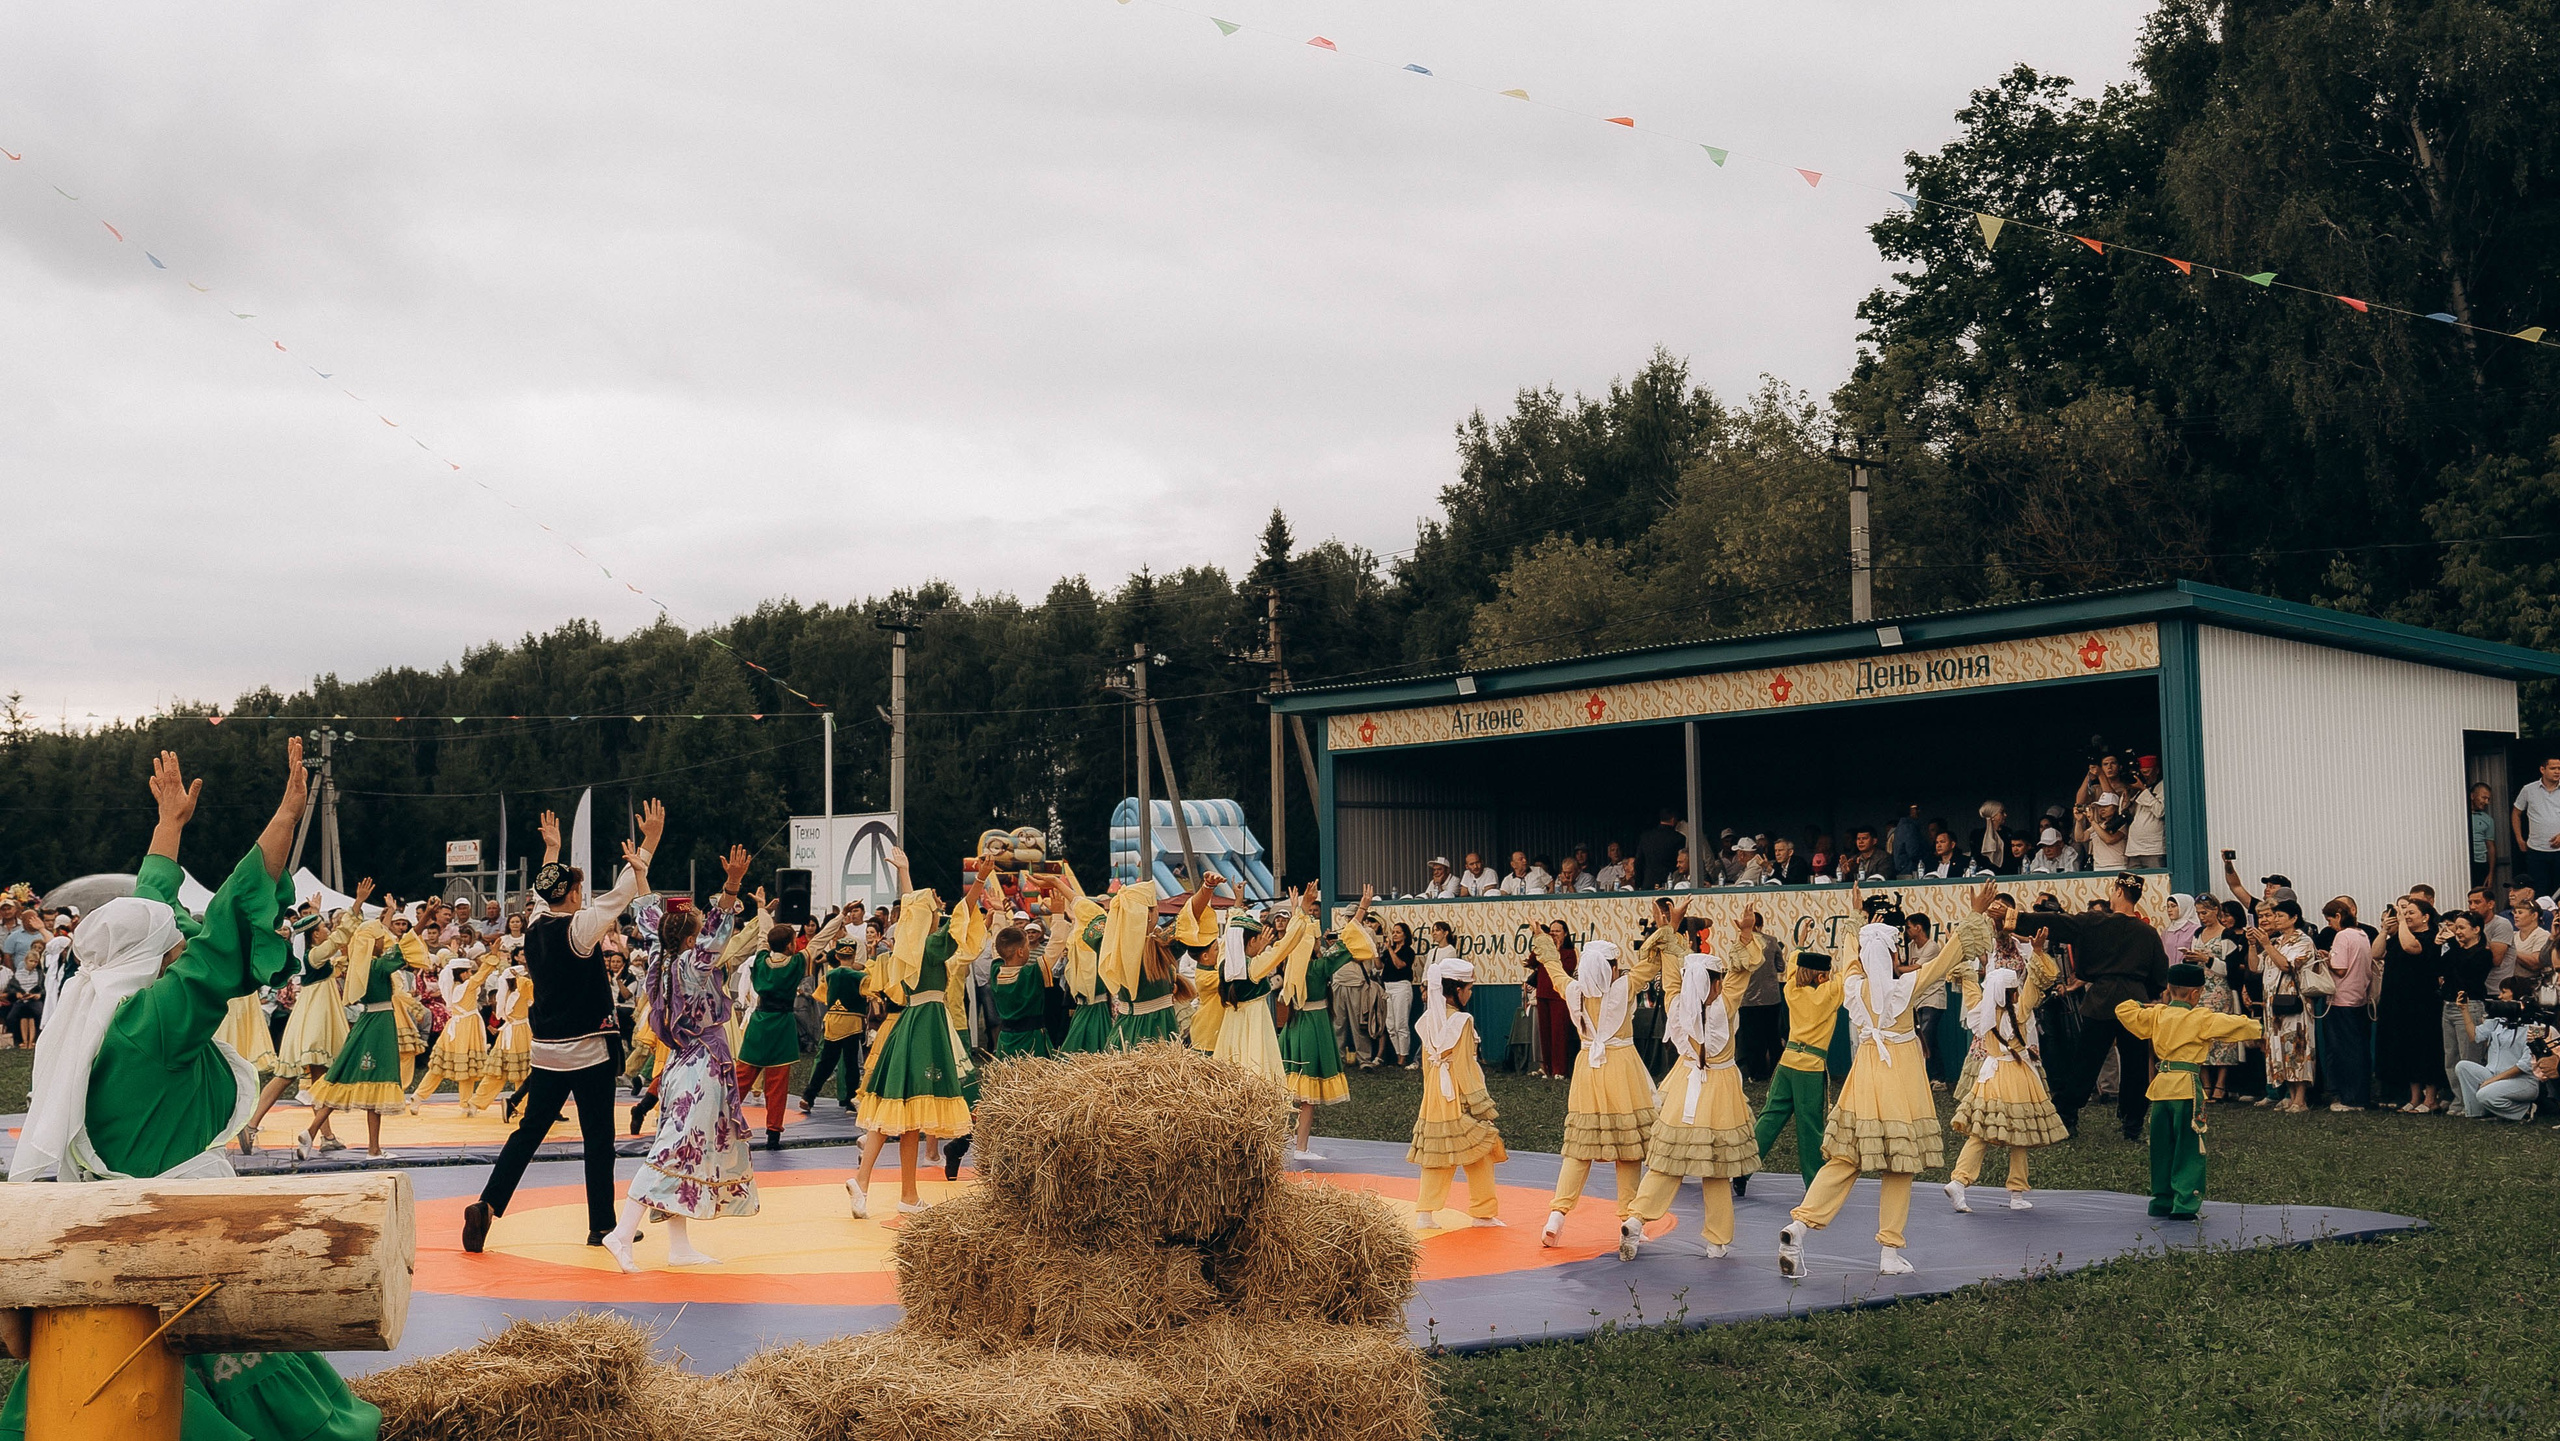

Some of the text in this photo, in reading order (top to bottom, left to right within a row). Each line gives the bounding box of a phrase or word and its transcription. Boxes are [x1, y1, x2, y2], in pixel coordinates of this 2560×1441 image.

[1856, 655, 1991, 694] День коня
[1452, 708, 1524, 734] Ат көне
[795, 825, 820, 841] Техно
[795, 844, 816, 862] Арск
[1793, 915, 1815, 949] С
